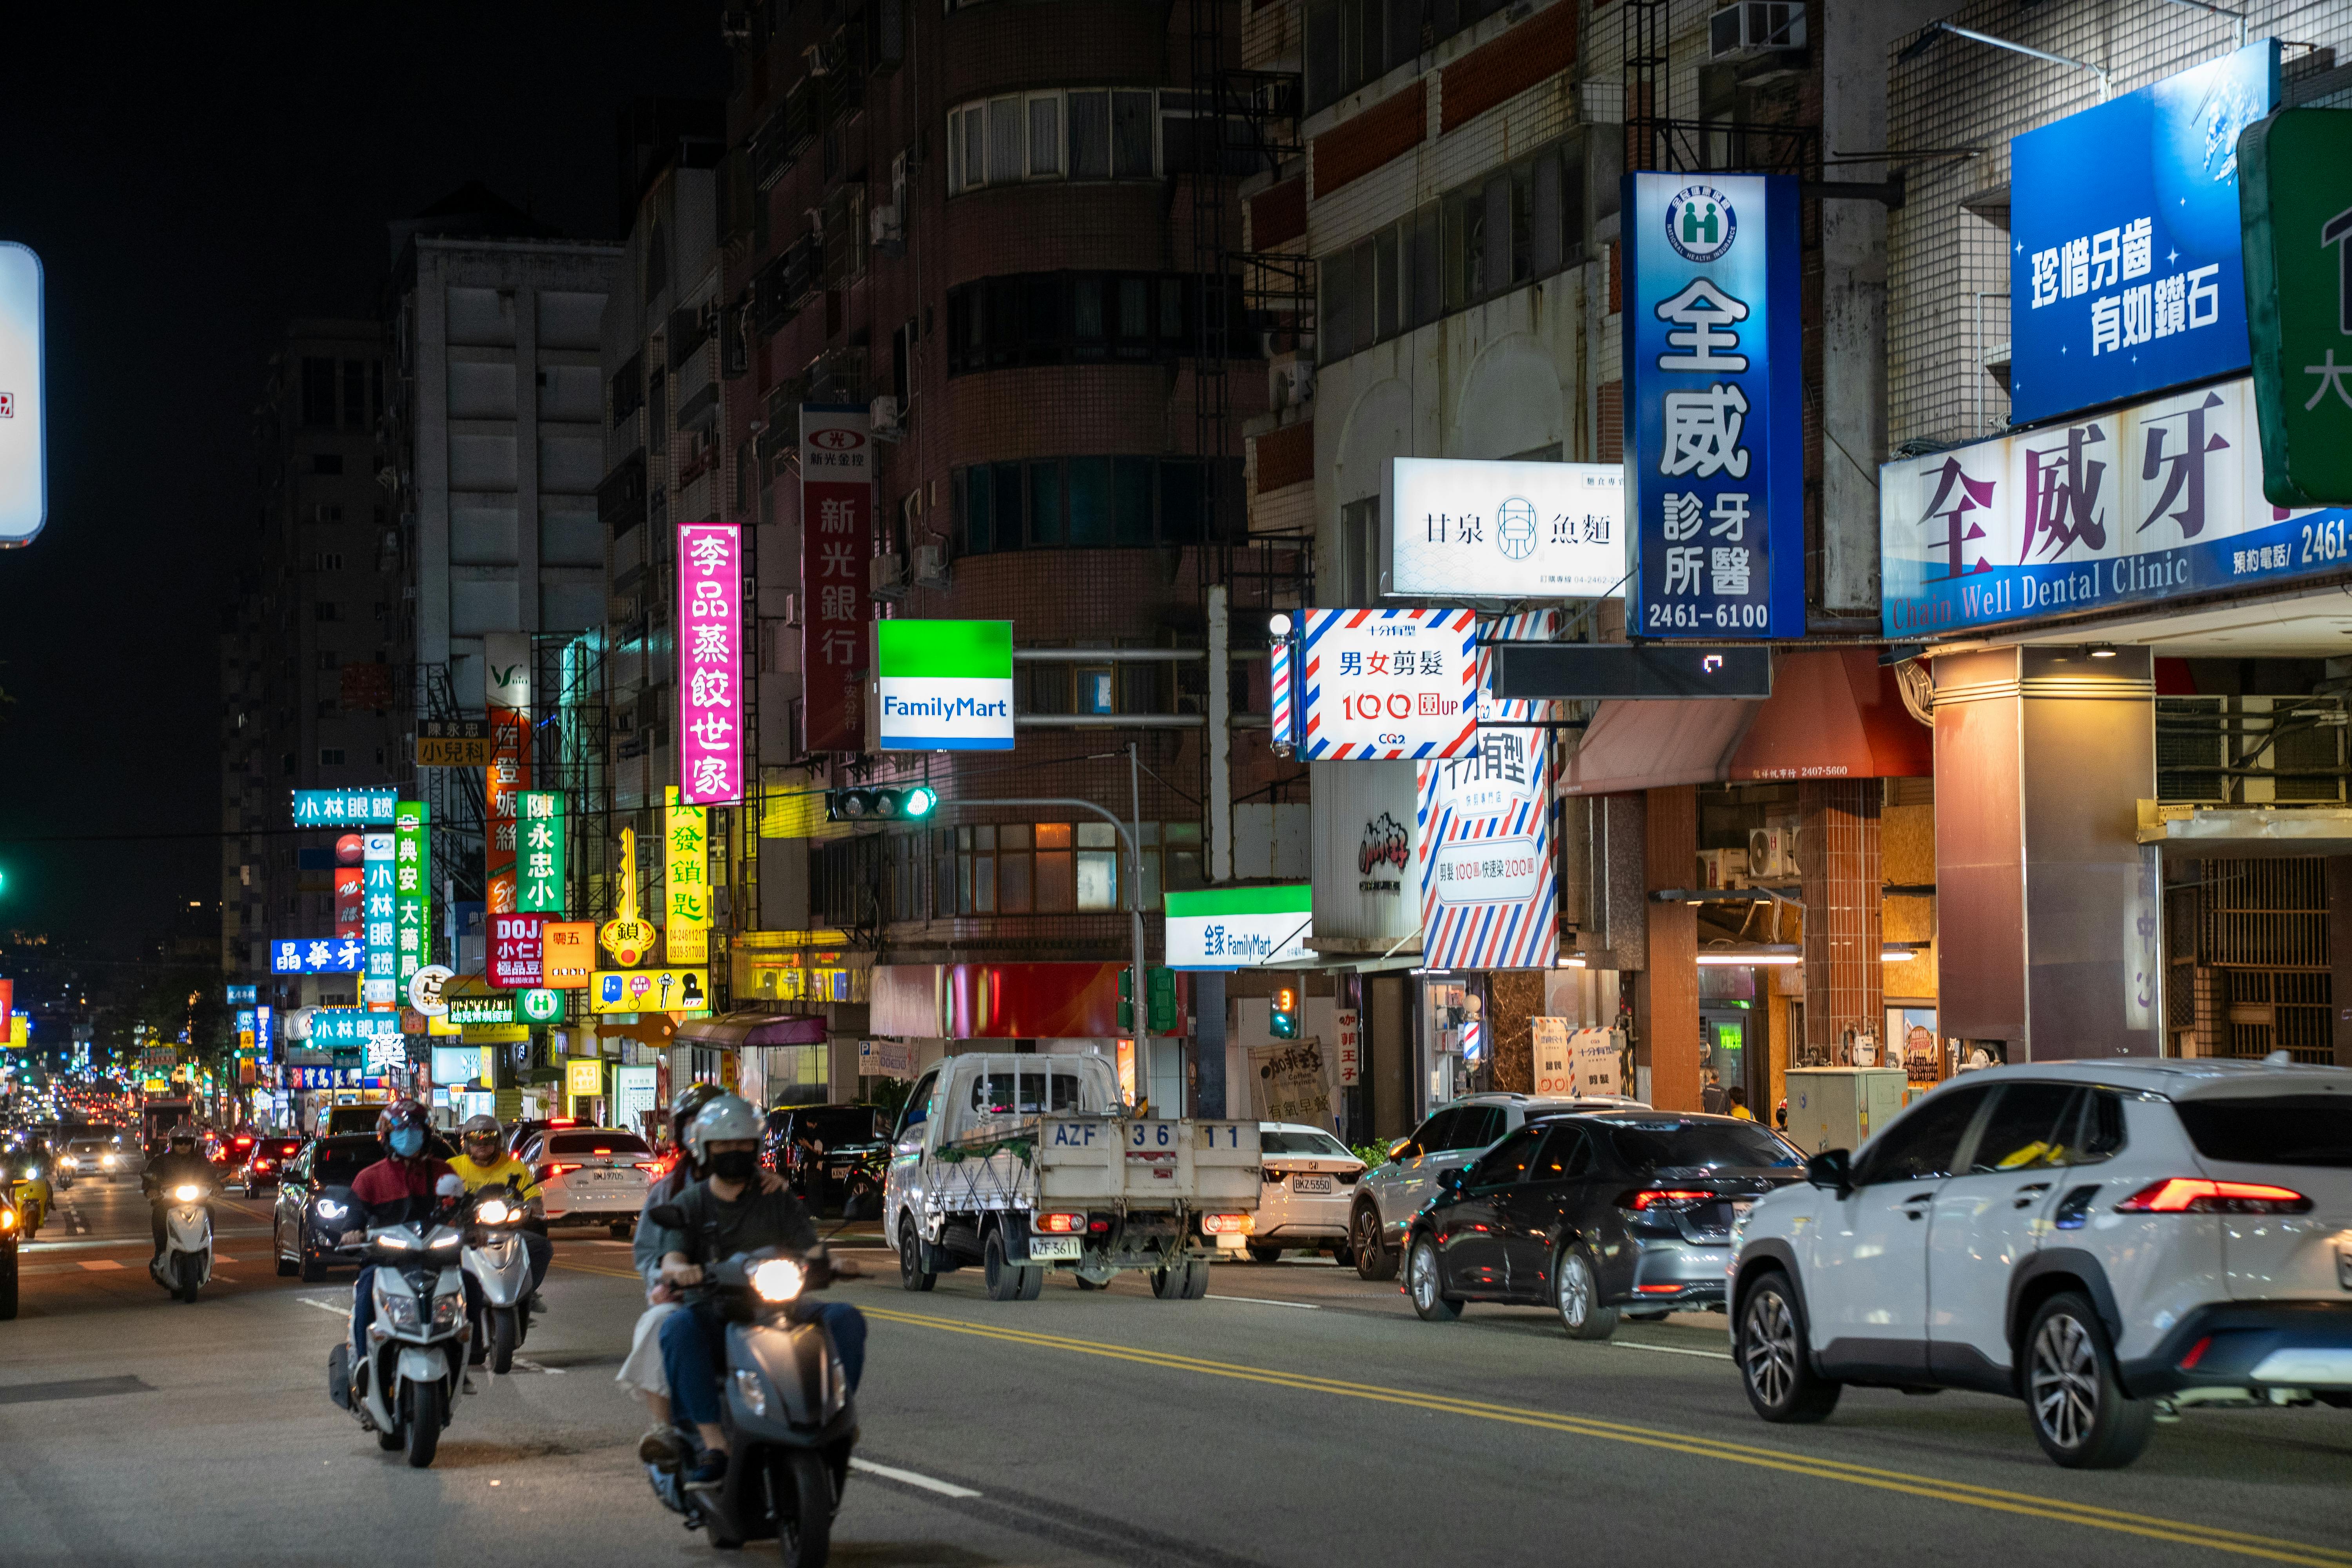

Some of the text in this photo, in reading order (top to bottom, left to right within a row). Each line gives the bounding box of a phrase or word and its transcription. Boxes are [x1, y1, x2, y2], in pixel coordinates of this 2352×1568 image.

[1672, 186, 1731, 212] 全民健康保險
[1666, 223, 1736, 261] NATIONAL HEALTH INSURANCE
[2031, 216, 2152, 310] 珍惜牙齒
[2091, 263, 2220, 357] 有如鑽石
[1655, 277, 1751, 479] 全威
[810, 452, 864, 466] 新光金控
[1916, 390, 2290, 584] 全威牙
[1422, 513, 1611, 544] 甘泉 魚麵
[820, 498, 857, 665] 新光銀行
[1574, 576, 1625, 584] 04-2462-22
[1892, 551, 2189, 630] Chain Well Dental Clinic
[1650, 603, 1768, 628] 2461-6100
[1366, 624, 1416, 636] 十分有型
[690, 534, 733, 795] 李品蒸餃世家
[1339, 650, 1443, 676] 男女剪髮
[884, 696, 1006, 722] FamilyMart
[422, 741, 485, 763] 小兒科
[299, 796, 393, 819] 小林眼鏡
[1466, 791, 1503, 807] 快剪專門店
[527, 794, 555, 912] 陳永忠小
[1440, 862, 1454, 881] 剪髮
[1482, 859, 1504, 878] 快速染
[494, 880, 516, 903] Sp
[370, 864, 394, 975] 小林眼鏡
[399, 838, 419, 980] 典安大藥局
[423, 926, 428, 939] An
[617, 922, 639, 940] 鎖
[669, 929, 705, 942] 04-24611217
[1204, 924, 1271, 962] 全家 FamilyMart
[276, 940, 361, 970] 晶華牙
[496, 960, 542, 976] 極品豆
[367, 1031, 406, 1070] 藥
[1055, 1123, 1096, 1146] AZF
